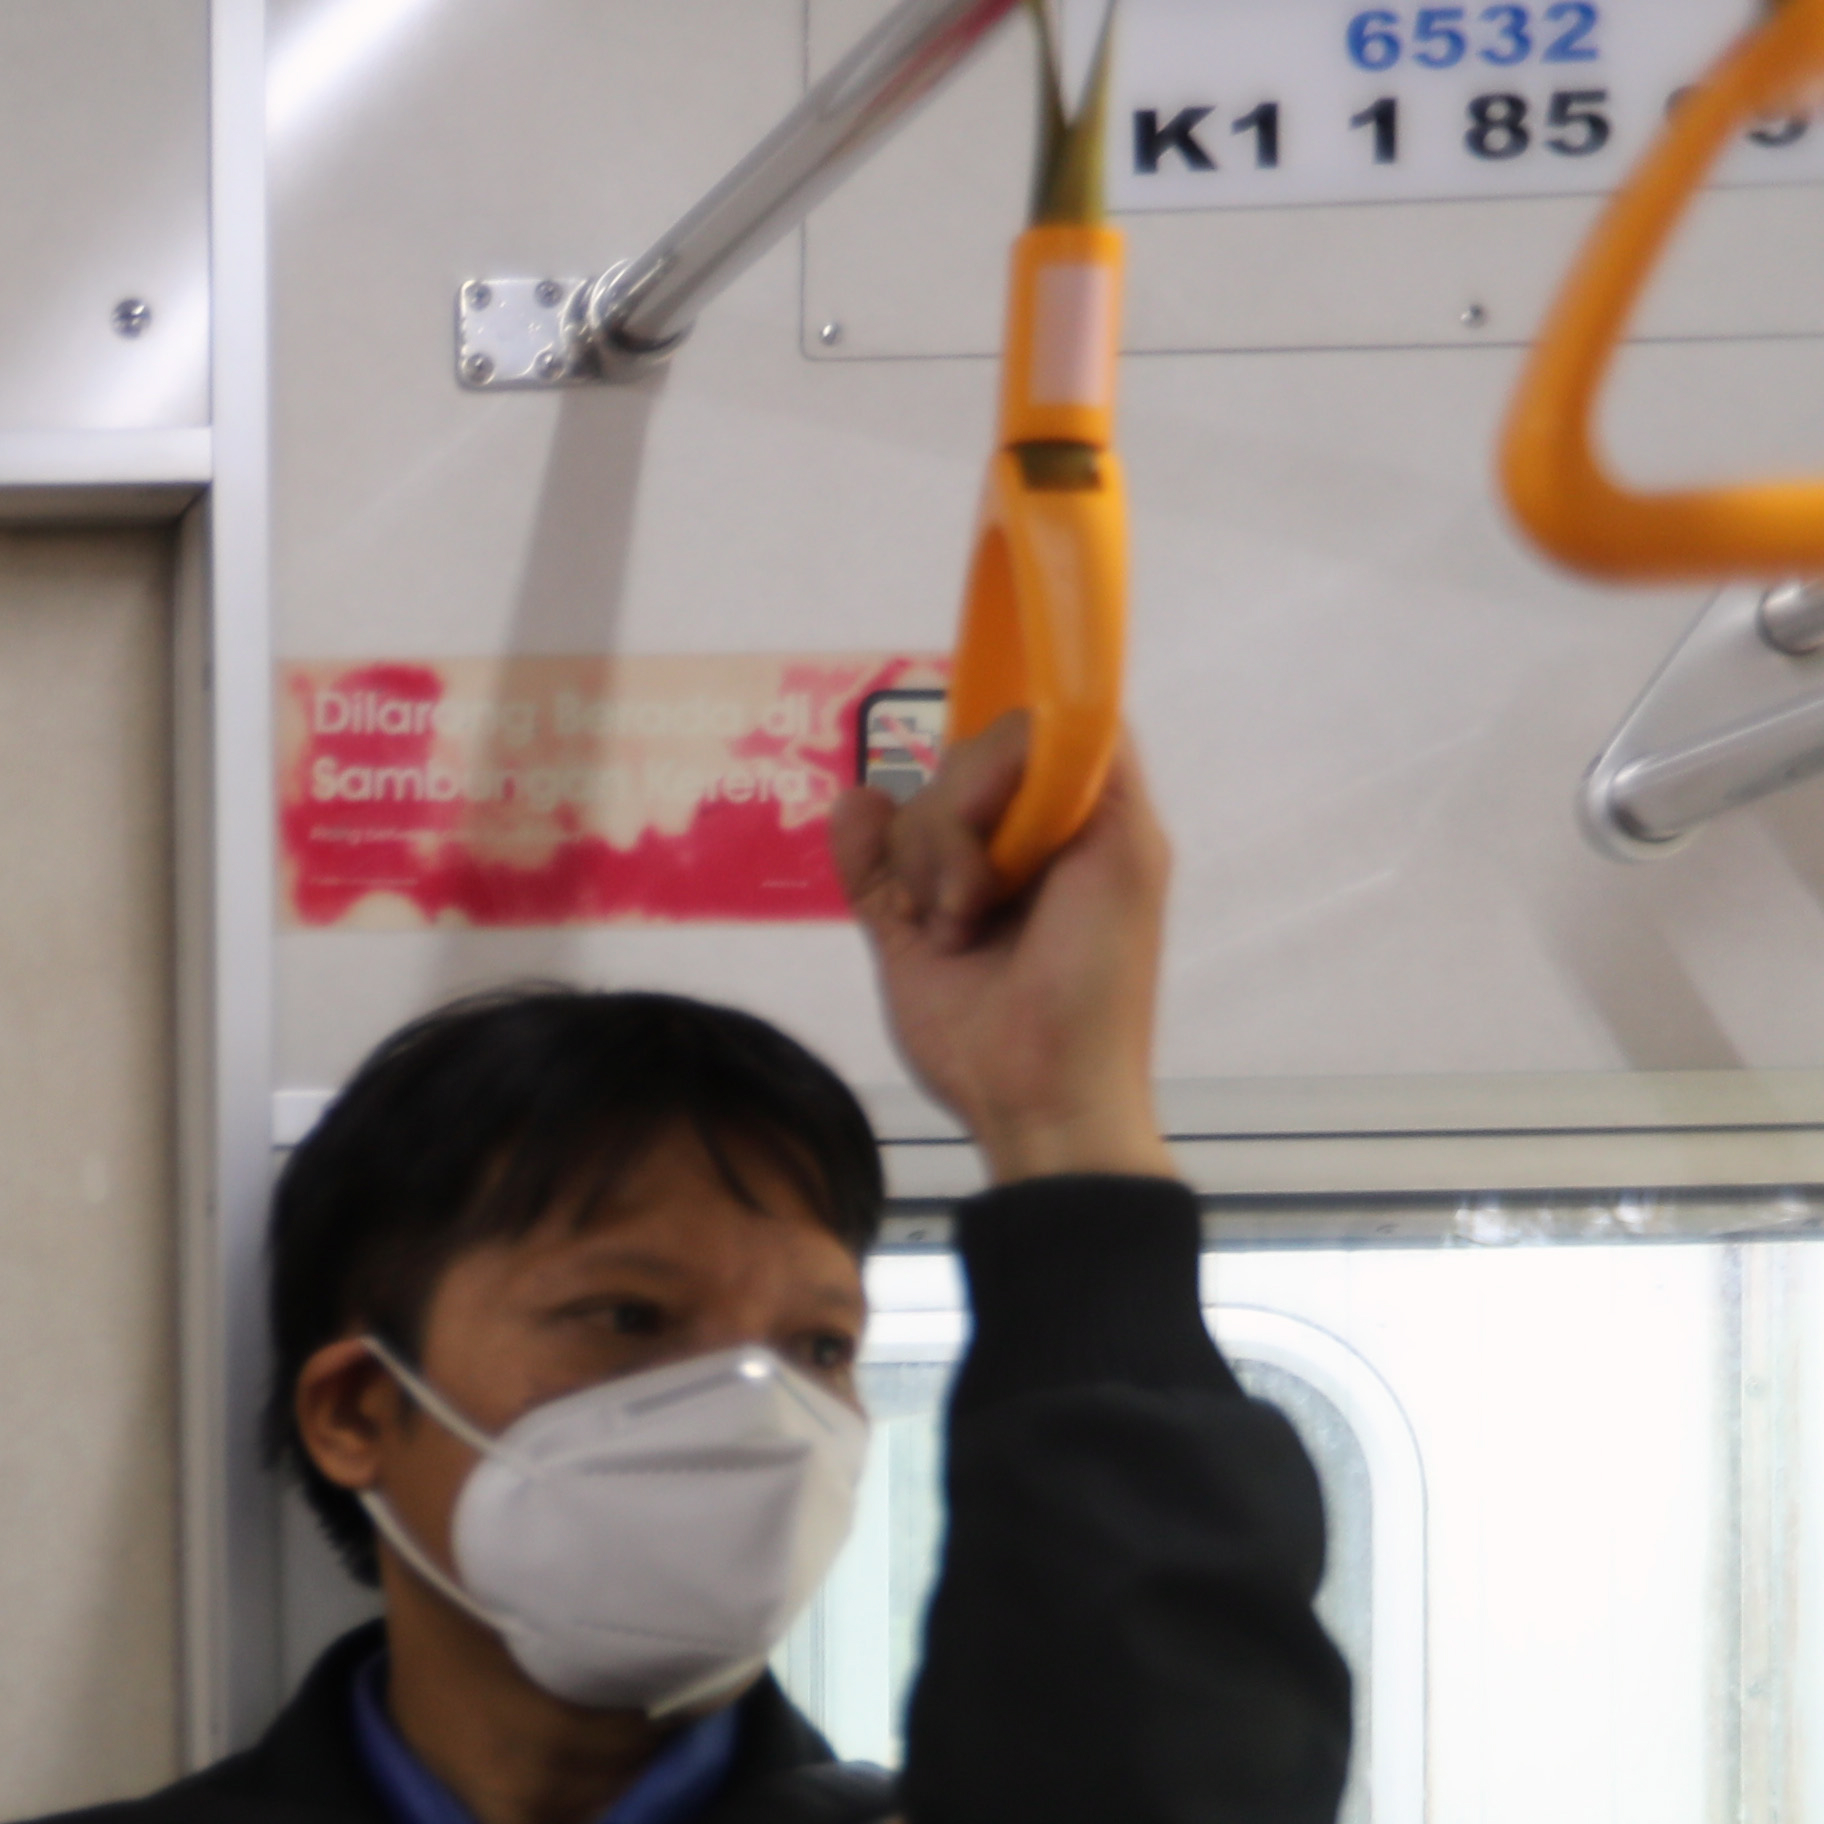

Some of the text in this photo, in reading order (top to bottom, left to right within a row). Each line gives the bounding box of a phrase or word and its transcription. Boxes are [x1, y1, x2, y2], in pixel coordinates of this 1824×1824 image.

[1345, 1, 1600, 73] 6532
[1132, 102, 1280, 175] K1
[1348, 97, 1398, 165] 1
[1464, 89, 1612, 161] 85
